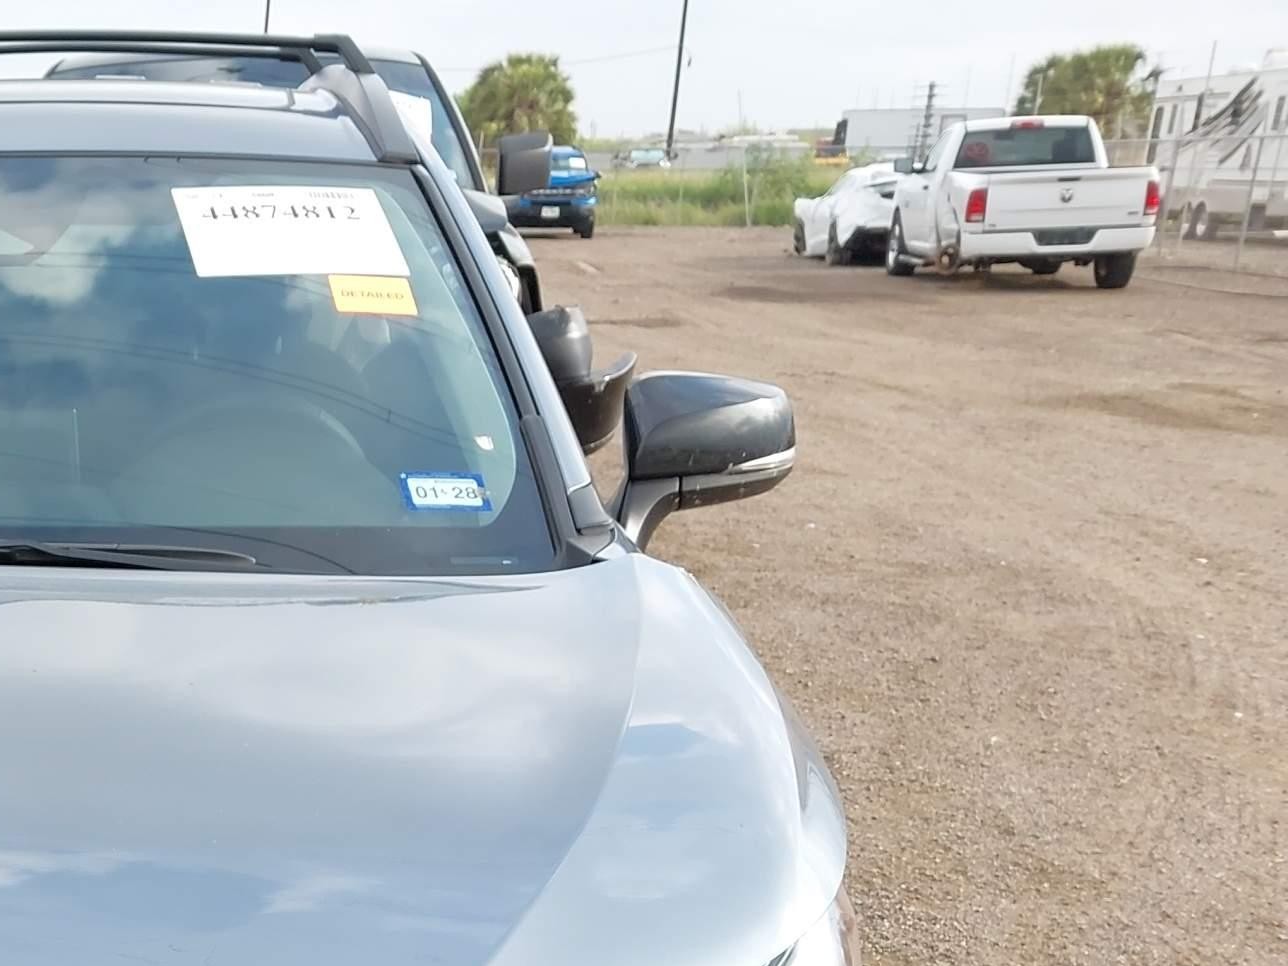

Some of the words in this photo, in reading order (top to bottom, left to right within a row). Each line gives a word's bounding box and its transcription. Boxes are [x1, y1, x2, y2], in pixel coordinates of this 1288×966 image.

[202, 205, 361, 220] 44874812
[415, 486, 439, 499] 01
[451, 486, 478, 500] 28
